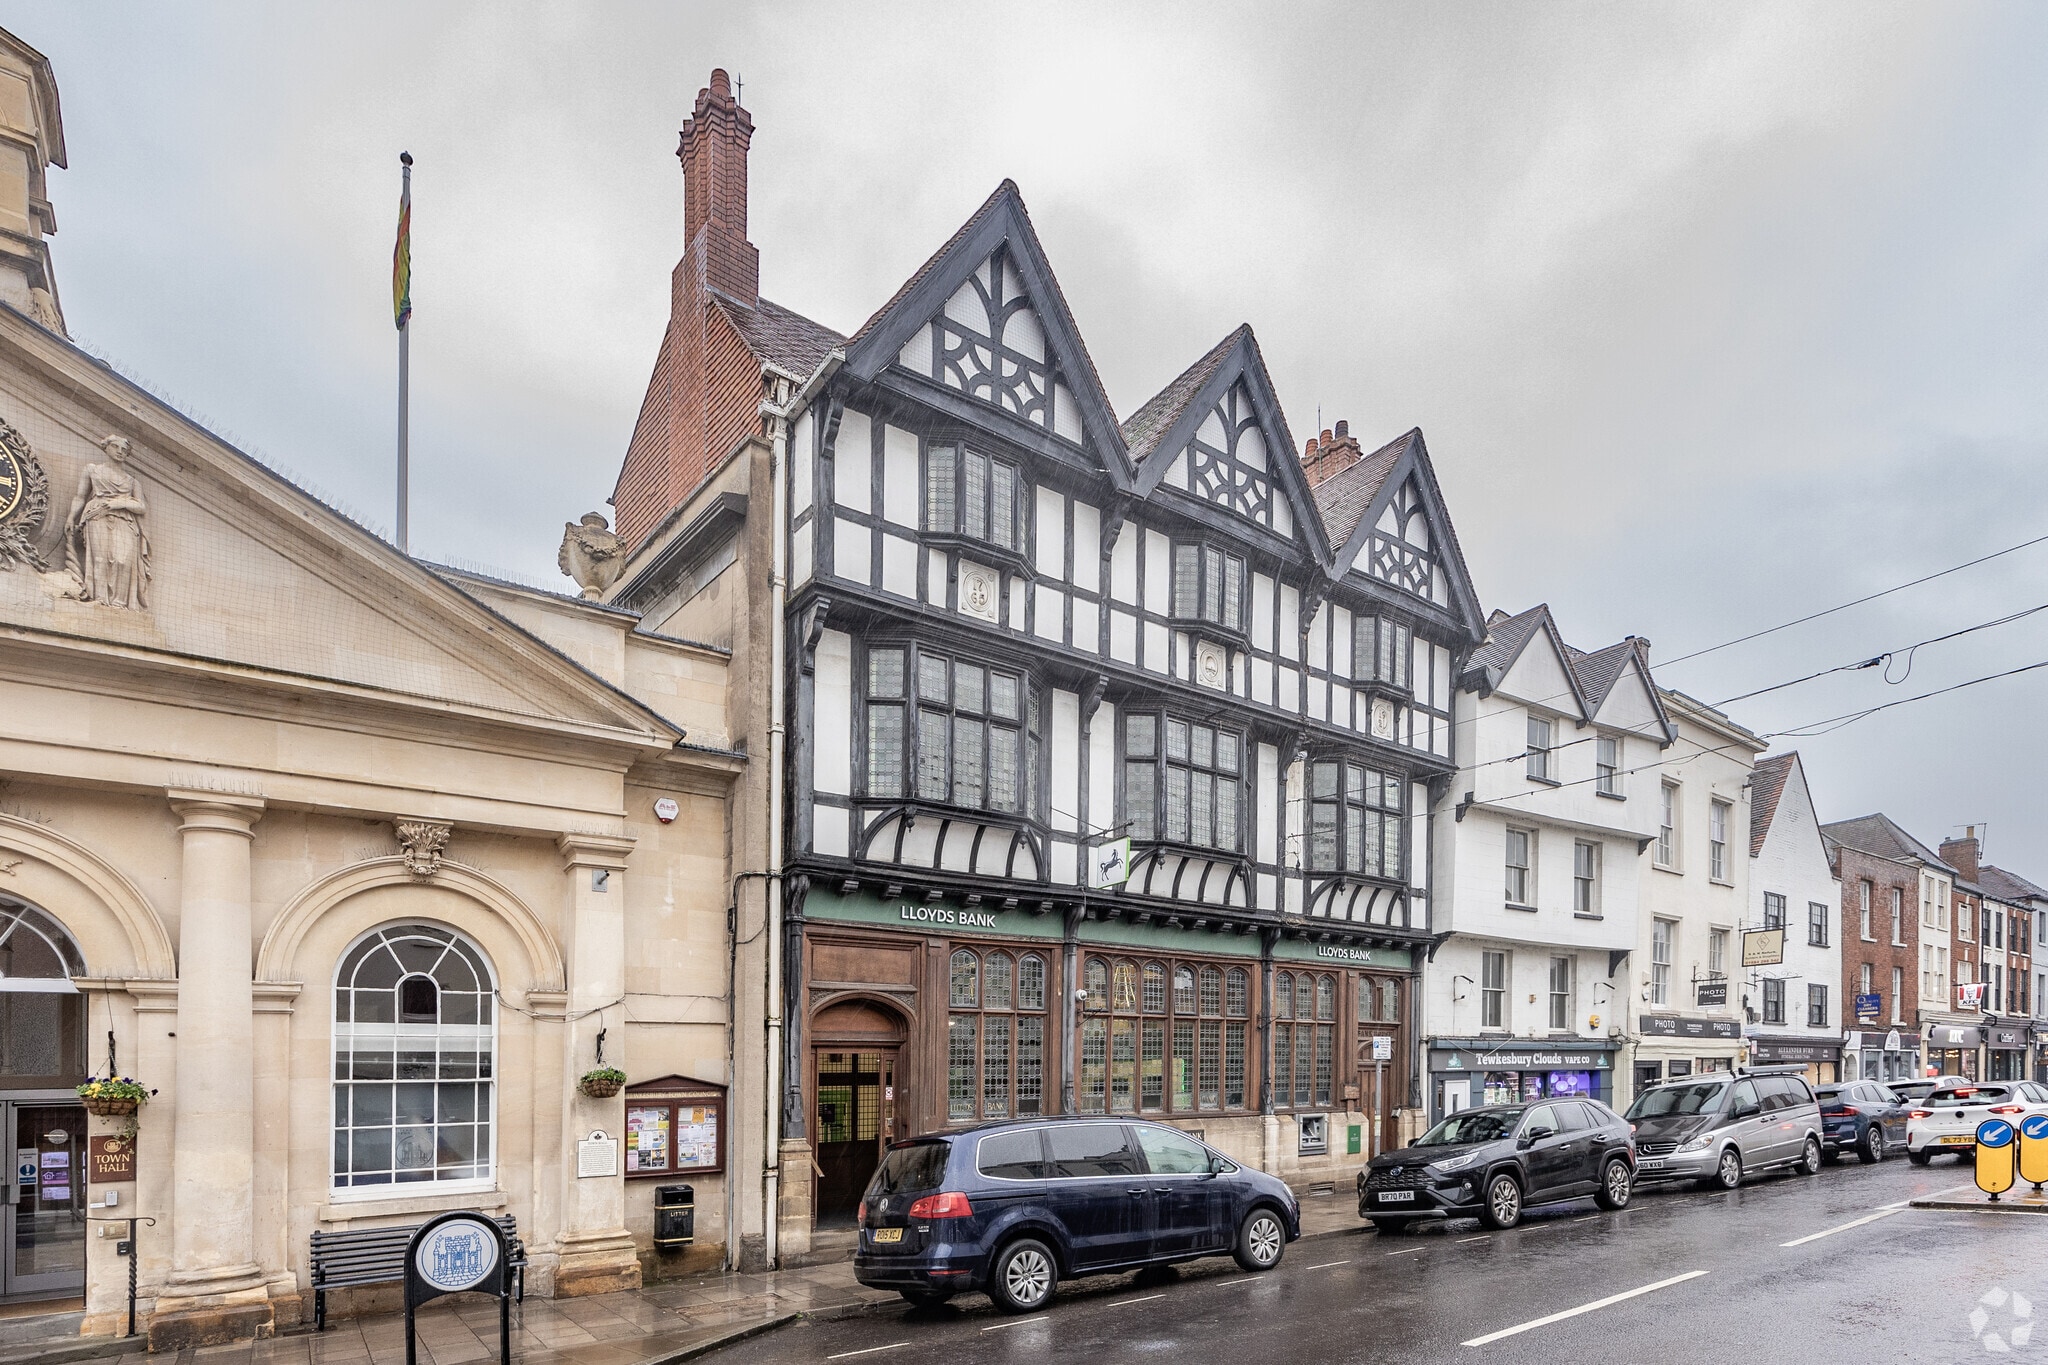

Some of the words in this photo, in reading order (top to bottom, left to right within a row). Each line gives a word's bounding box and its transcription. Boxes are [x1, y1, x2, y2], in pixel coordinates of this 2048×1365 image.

[901, 905, 955, 924] LLOYDS
[958, 911, 996, 928] BANK
[1318, 945, 1348, 959] LLOYDS
[1349, 949, 1371, 961] BANK
[1699, 988, 1726, 996] PHOTO
[1654, 1019, 1676, 1029] PHOTO
[1713, 1022, 1731, 1031] PHOTO
[1476, 1053, 1532, 1067] Tewkesbury
[1533, 1053, 1562, 1064] Clouds
[1564, 1056, 1581, 1064] VAPE
[1581, 1056, 1590, 1064] CO
[94, 1153, 130, 1164] TOWN
[99, 1163, 129, 1173] HALL
[1381, 1192, 1398, 1201] BR70
[1398, 1191, 1412, 1200] PAR
